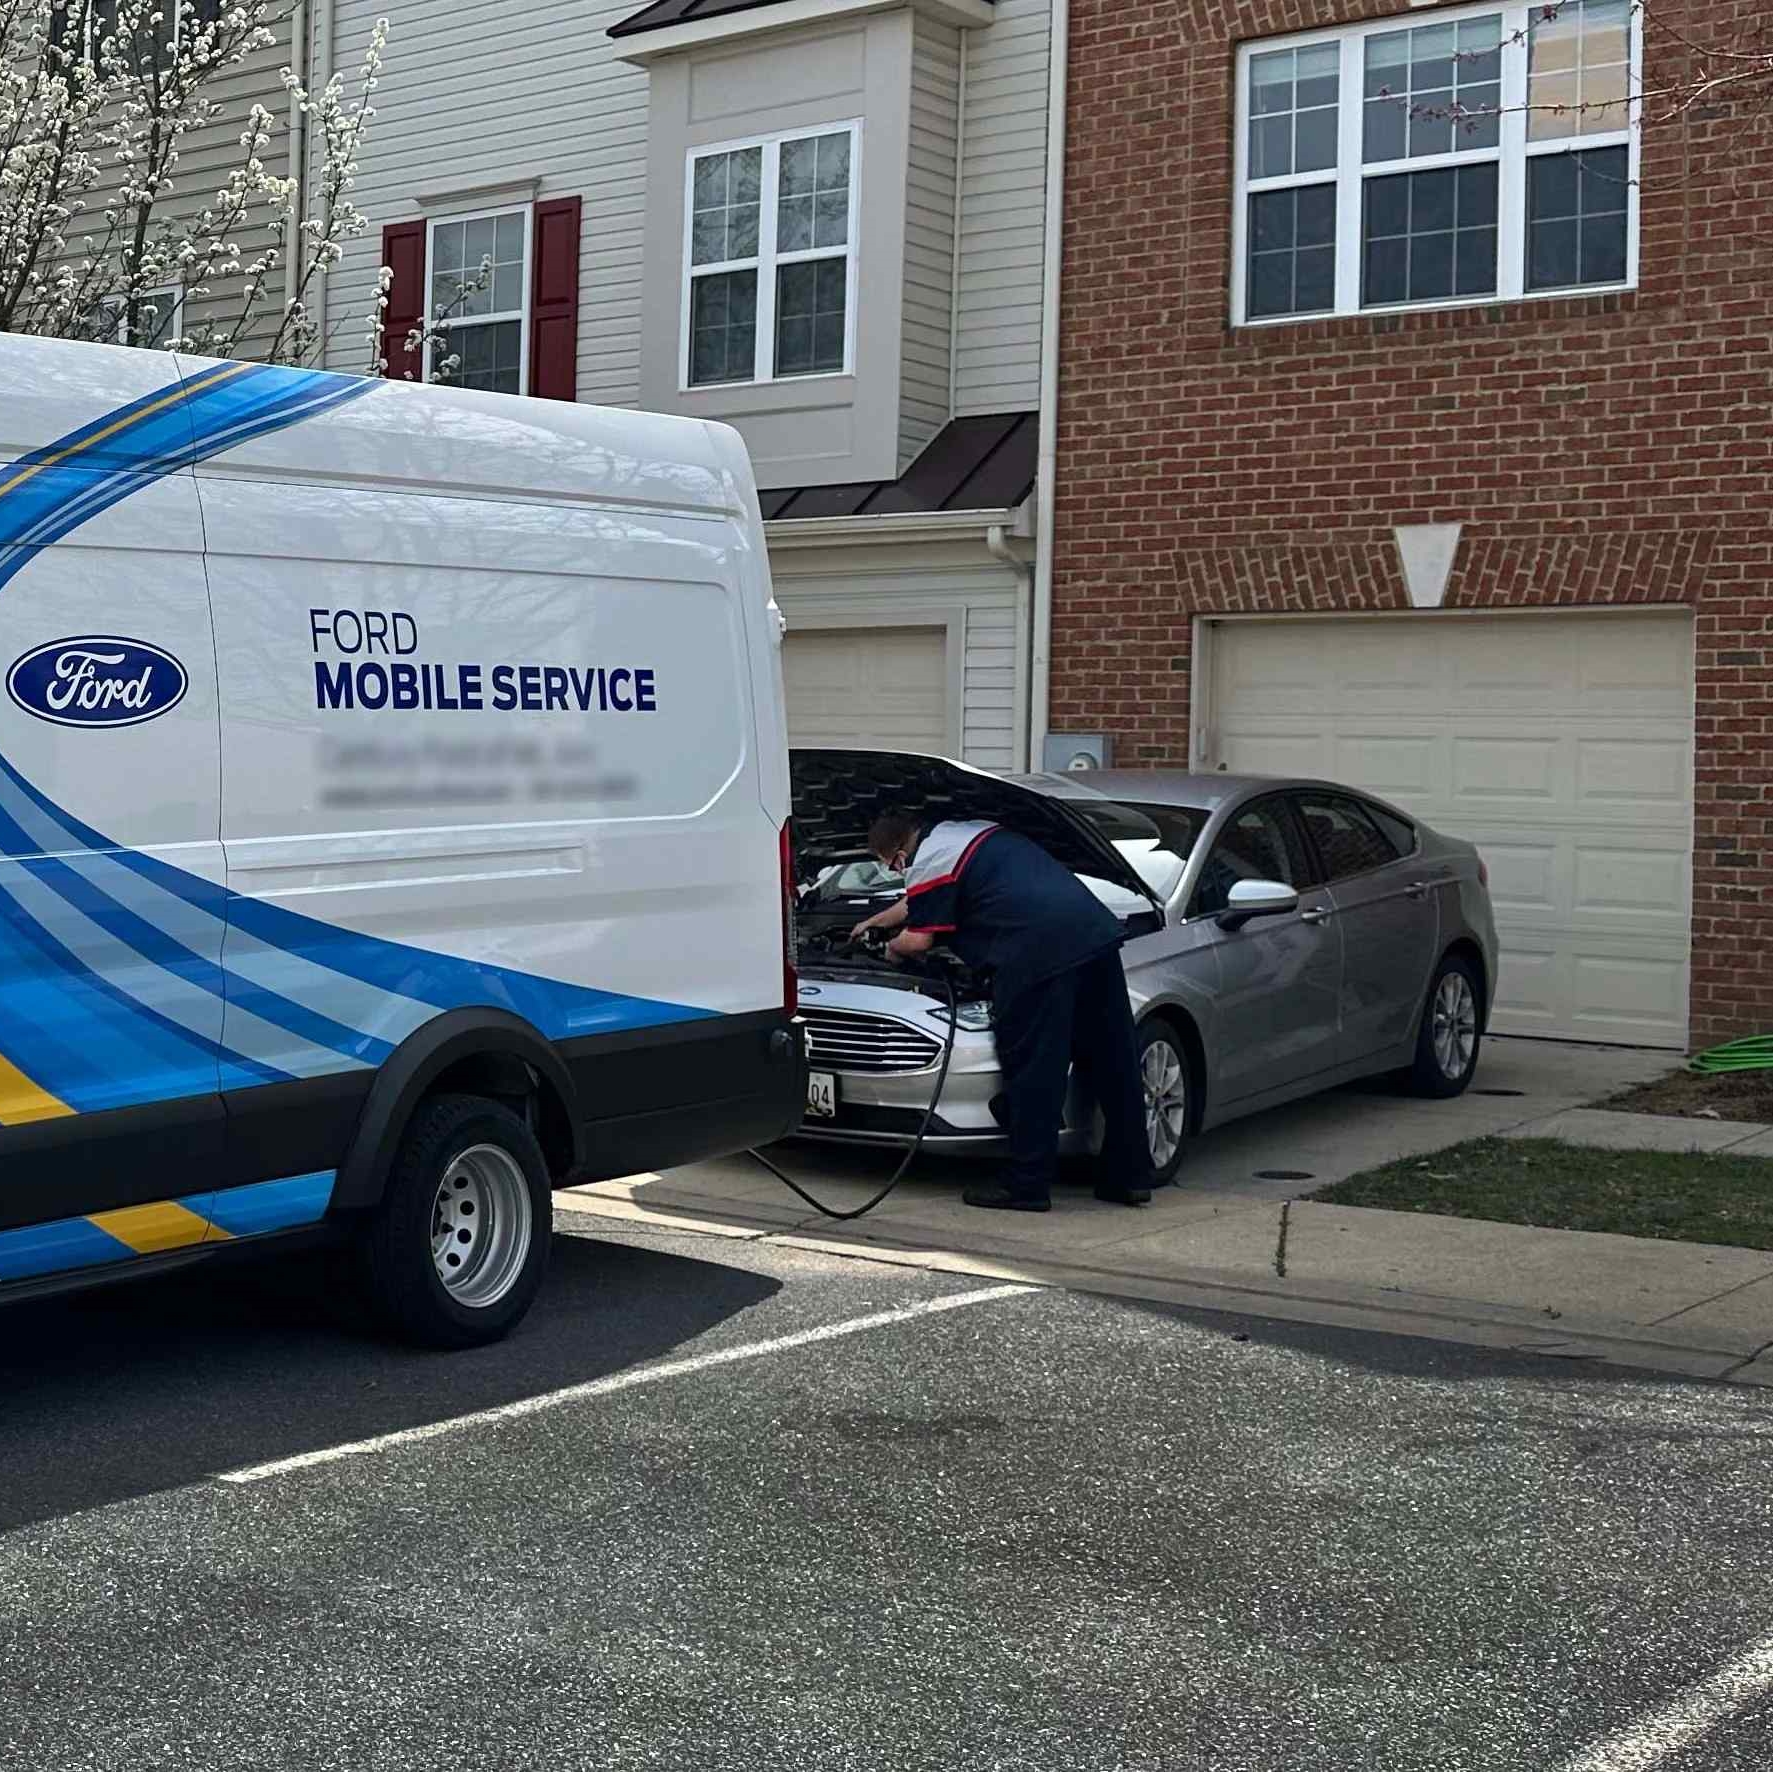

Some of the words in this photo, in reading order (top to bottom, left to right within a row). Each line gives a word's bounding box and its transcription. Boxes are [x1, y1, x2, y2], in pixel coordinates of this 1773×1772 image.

[309, 608, 418, 655] FORD
[46, 651, 152, 710] Ford
[314, 661, 483, 710] MOBILE
[491, 665, 657, 711] SERVICE
